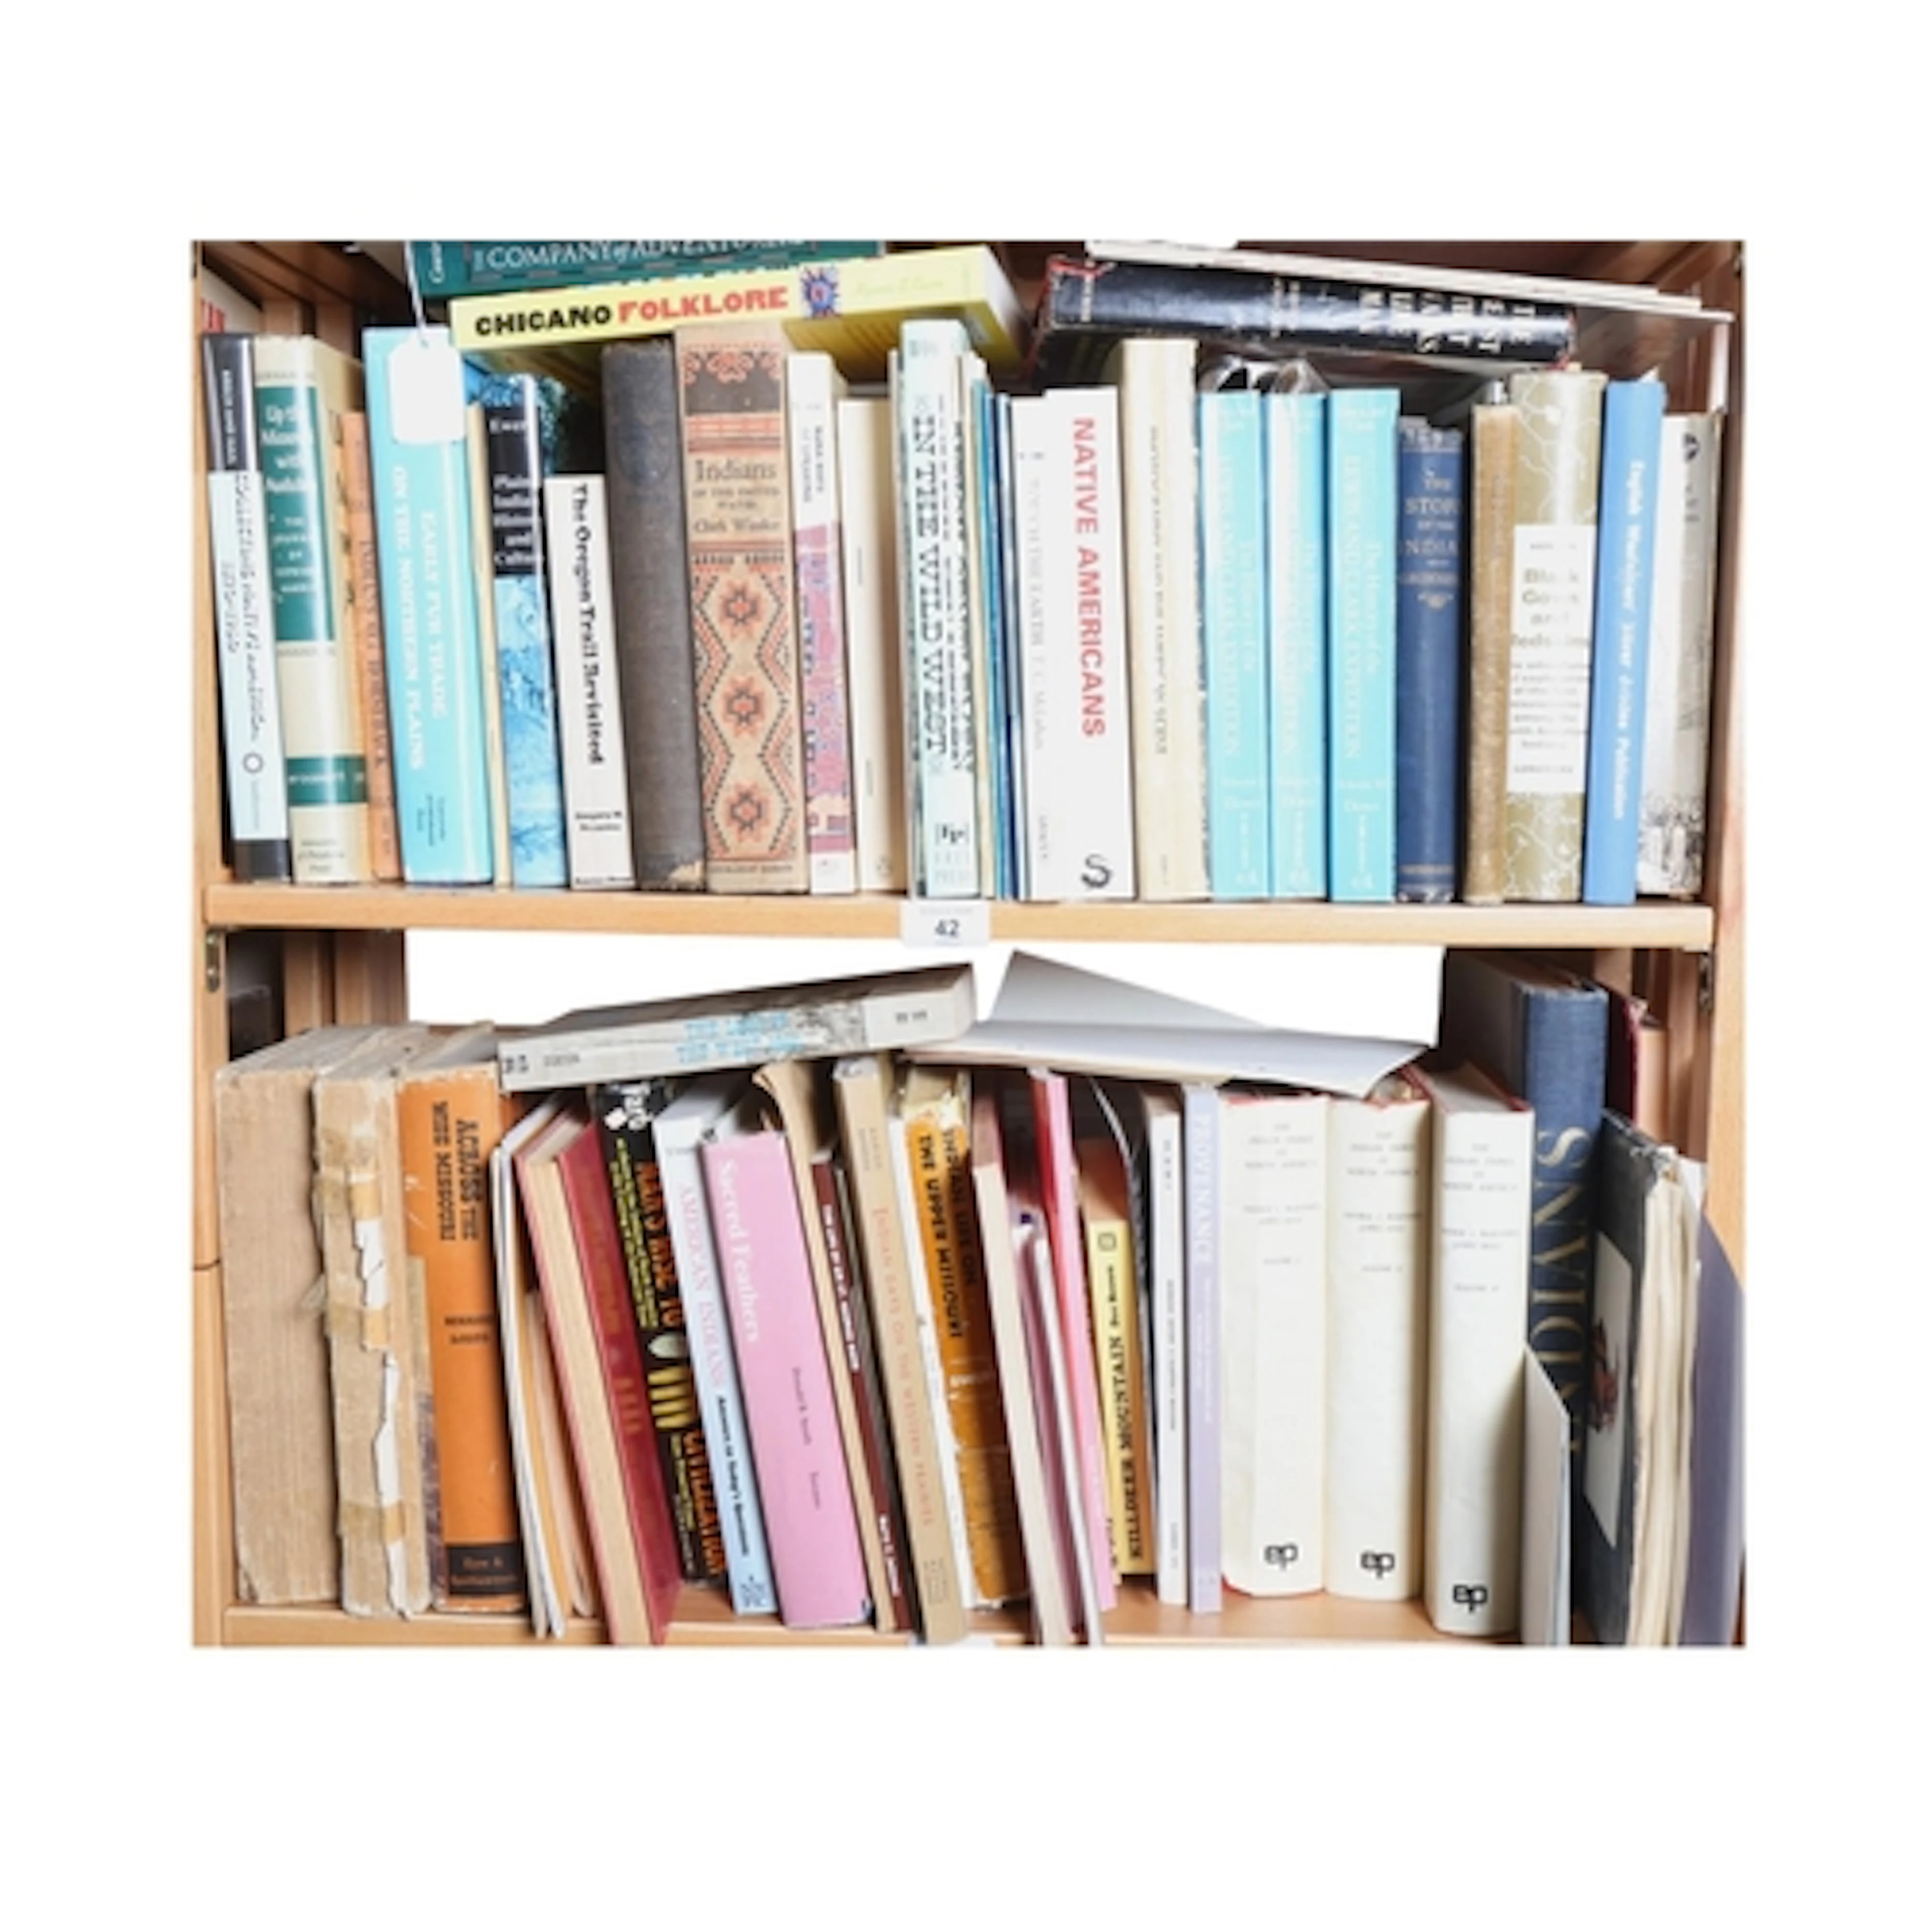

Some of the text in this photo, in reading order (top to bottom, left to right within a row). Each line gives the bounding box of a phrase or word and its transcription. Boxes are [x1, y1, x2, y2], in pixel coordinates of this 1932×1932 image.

[475, 286, 788, 336] CHICANO FOLKLORE
[486, 242, 603, 269] COMPANY
[694, 457, 778, 482] Indians
[913, 416, 936, 455] IN
[1626, 460, 1646, 515] English
[915, 461, 939, 537] THE
[392, 465, 426, 771] ON THE NORTHERN PLAINS
[420, 510, 448, 718] EARLY FUR TRADE
[573, 484, 605, 764] The Oregon Trail Revisited
[919, 543, 945, 641] WILD
[1030, 584, 1044, 647] EARTH
[1072, 417, 1106, 738] NATIVE AMERICANS
[1343, 573, 1361, 633] CLARK
[923, 649, 947, 755] WEST
[1343, 641, 1362, 758] EXPEDITION
[1613, 736, 1631, 820] Publication
[935, 919, 959, 938] 42
[435, 1151, 457, 1241] MISSOURI
[456, 1119, 483, 1241] ACROSS THE
[942, 1130, 978, 1287] INDIAN LIFE ON
[1193, 1113, 1213, 1265] PROVENANCE
[680, 1183, 713, 1292] AMERICAN
[700, 1301, 731, 1388] INDIANS
[720, 1159, 762, 1343] Sacred Feathers
[919, 1134, 964, 1338] THE UPPER MISSOURI
[1529, 1128, 1591, 1454] DIANS
[872, 1207, 893, 1267] INDIAN
[891, 1322, 905, 1346] ON
[902, 1388, 923, 1455] WESTERN
[1108, 1335, 1133, 1451] MOUNTAIN
[1118, 1458, 1143, 1560] KILLDEER
